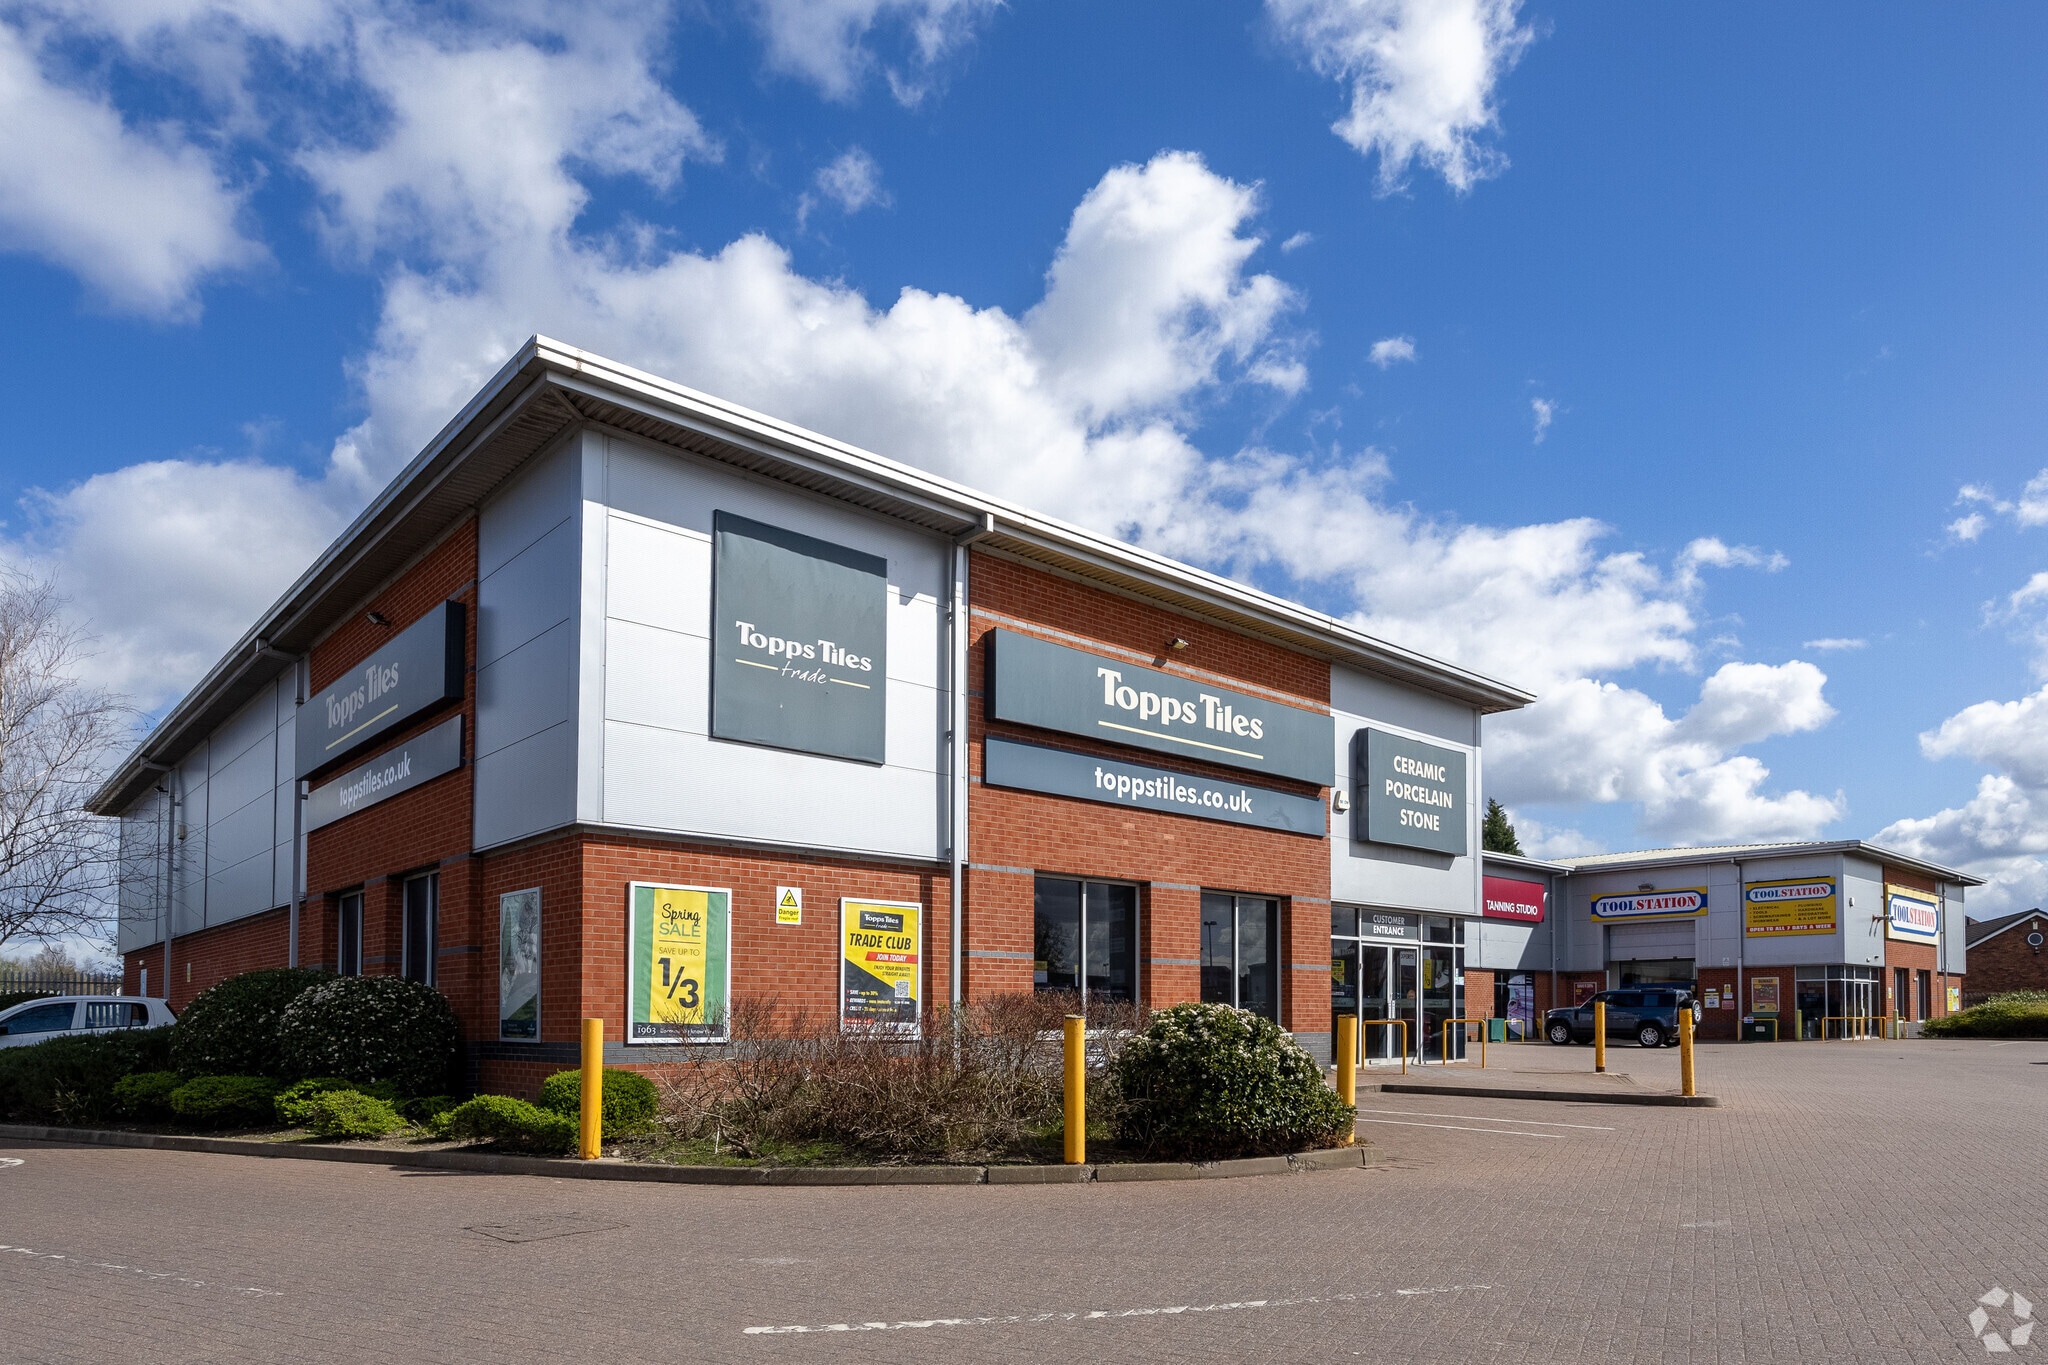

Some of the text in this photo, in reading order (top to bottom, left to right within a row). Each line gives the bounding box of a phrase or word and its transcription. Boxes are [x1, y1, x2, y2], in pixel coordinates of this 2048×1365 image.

[736, 621, 872, 672] Topps Tiles
[781, 660, 827, 684] trade
[326, 662, 399, 729] Topps Tiles
[1097, 667, 1263, 740] Topps Tiles
[1393, 755, 1446, 783] CERAMIC
[340, 751, 411, 809] toppstiles.co.uk
[1094, 766, 1253, 814] toppstiles.co.uk
[1385, 779, 1453, 809] PORCELAIN
[1400, 808, 1440, 832] STONE
[1752, 886, 1828, 899] TOOLSTATION
[778, 908, 799, 917] Danger
[1486, 899, 1538, 916] TANNING STUDIO
[1600, 896, 1697, 912] TOOLSTATION
[661, 903, 702, 927] Spring
[864, 914, 899, 924] Topps Tiles
[1373, 914, 1405, 925] CUSTOMER
[1892, 903, 1935, 928] TOOLSTATION
[659, 922, 701, 938] SALE
[1373, 925, 1405, 936] ENTRANCE
[659, 947, 700, 956] SAVE UP TO
[849, 933, 912, 950] TRADE CLUB
[876, 953, 907, 962] JOIN TODAY
[657, 957, 700, 1008] 1/3
[637, 1024, 656, 1035] 1963
